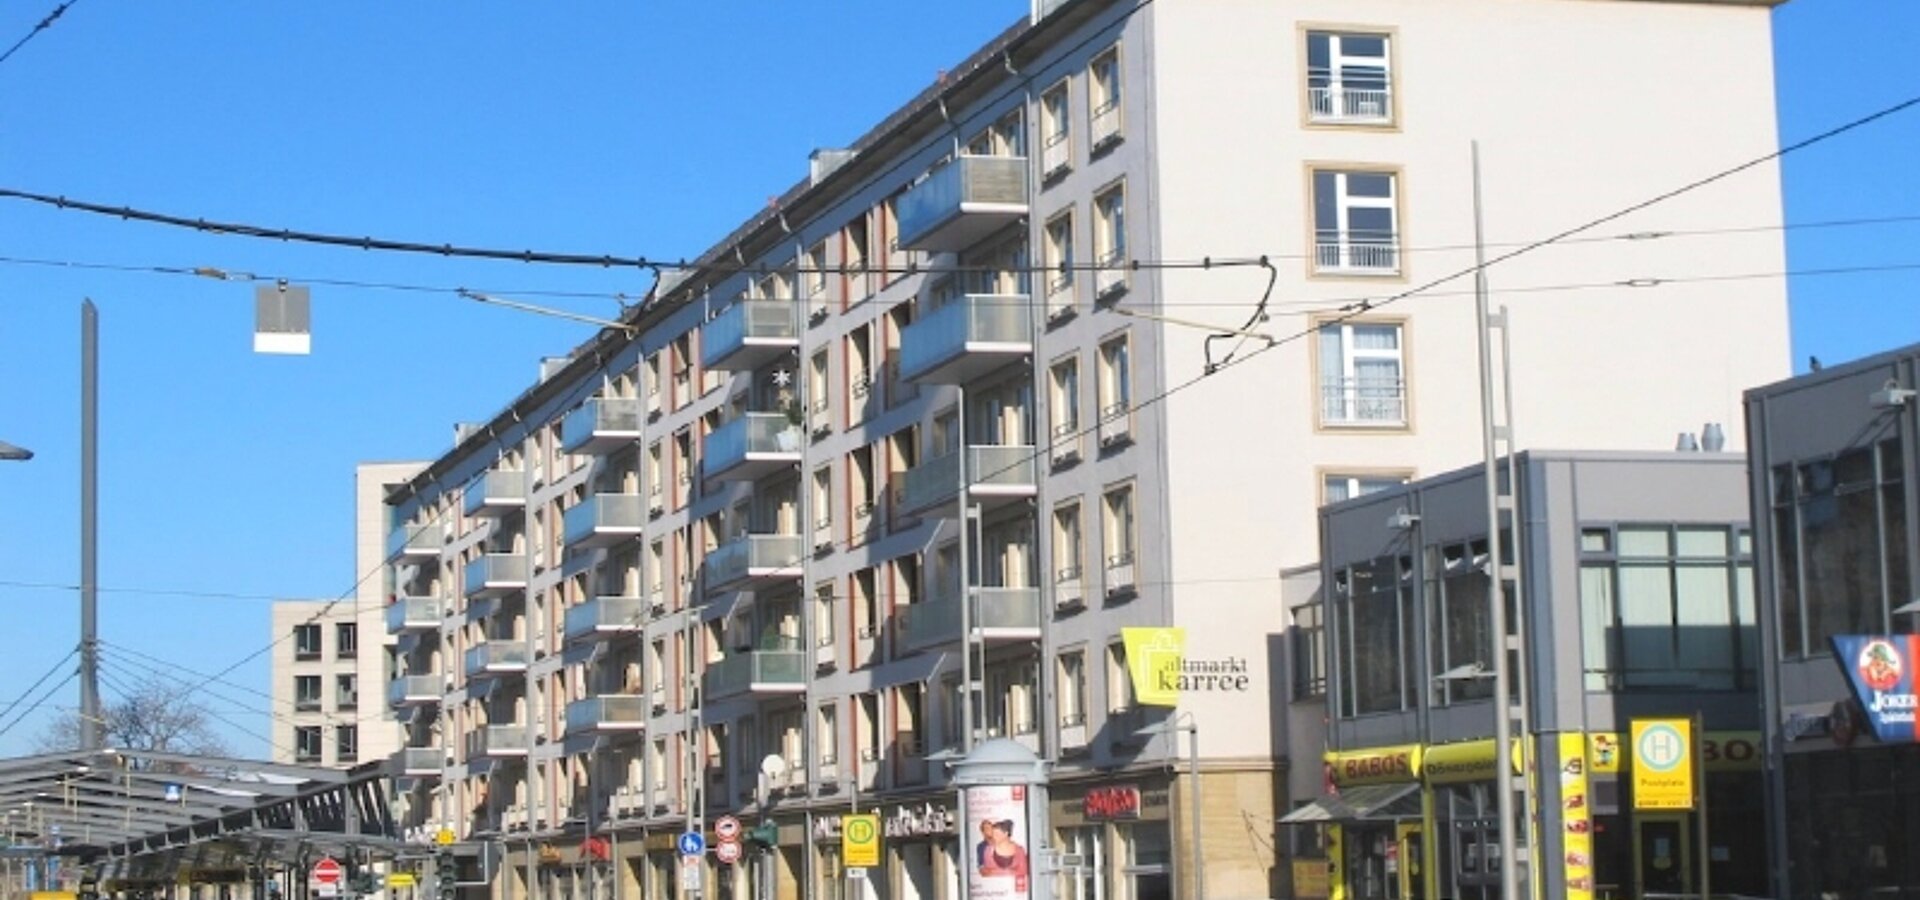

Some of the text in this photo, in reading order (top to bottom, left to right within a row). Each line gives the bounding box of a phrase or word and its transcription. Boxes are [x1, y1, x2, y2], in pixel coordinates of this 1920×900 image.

[1163, 656, 1247, 673] altmarkt
[1650, 734, 1671, 761] H
[1345, 753, 1407, 779] BABOS
